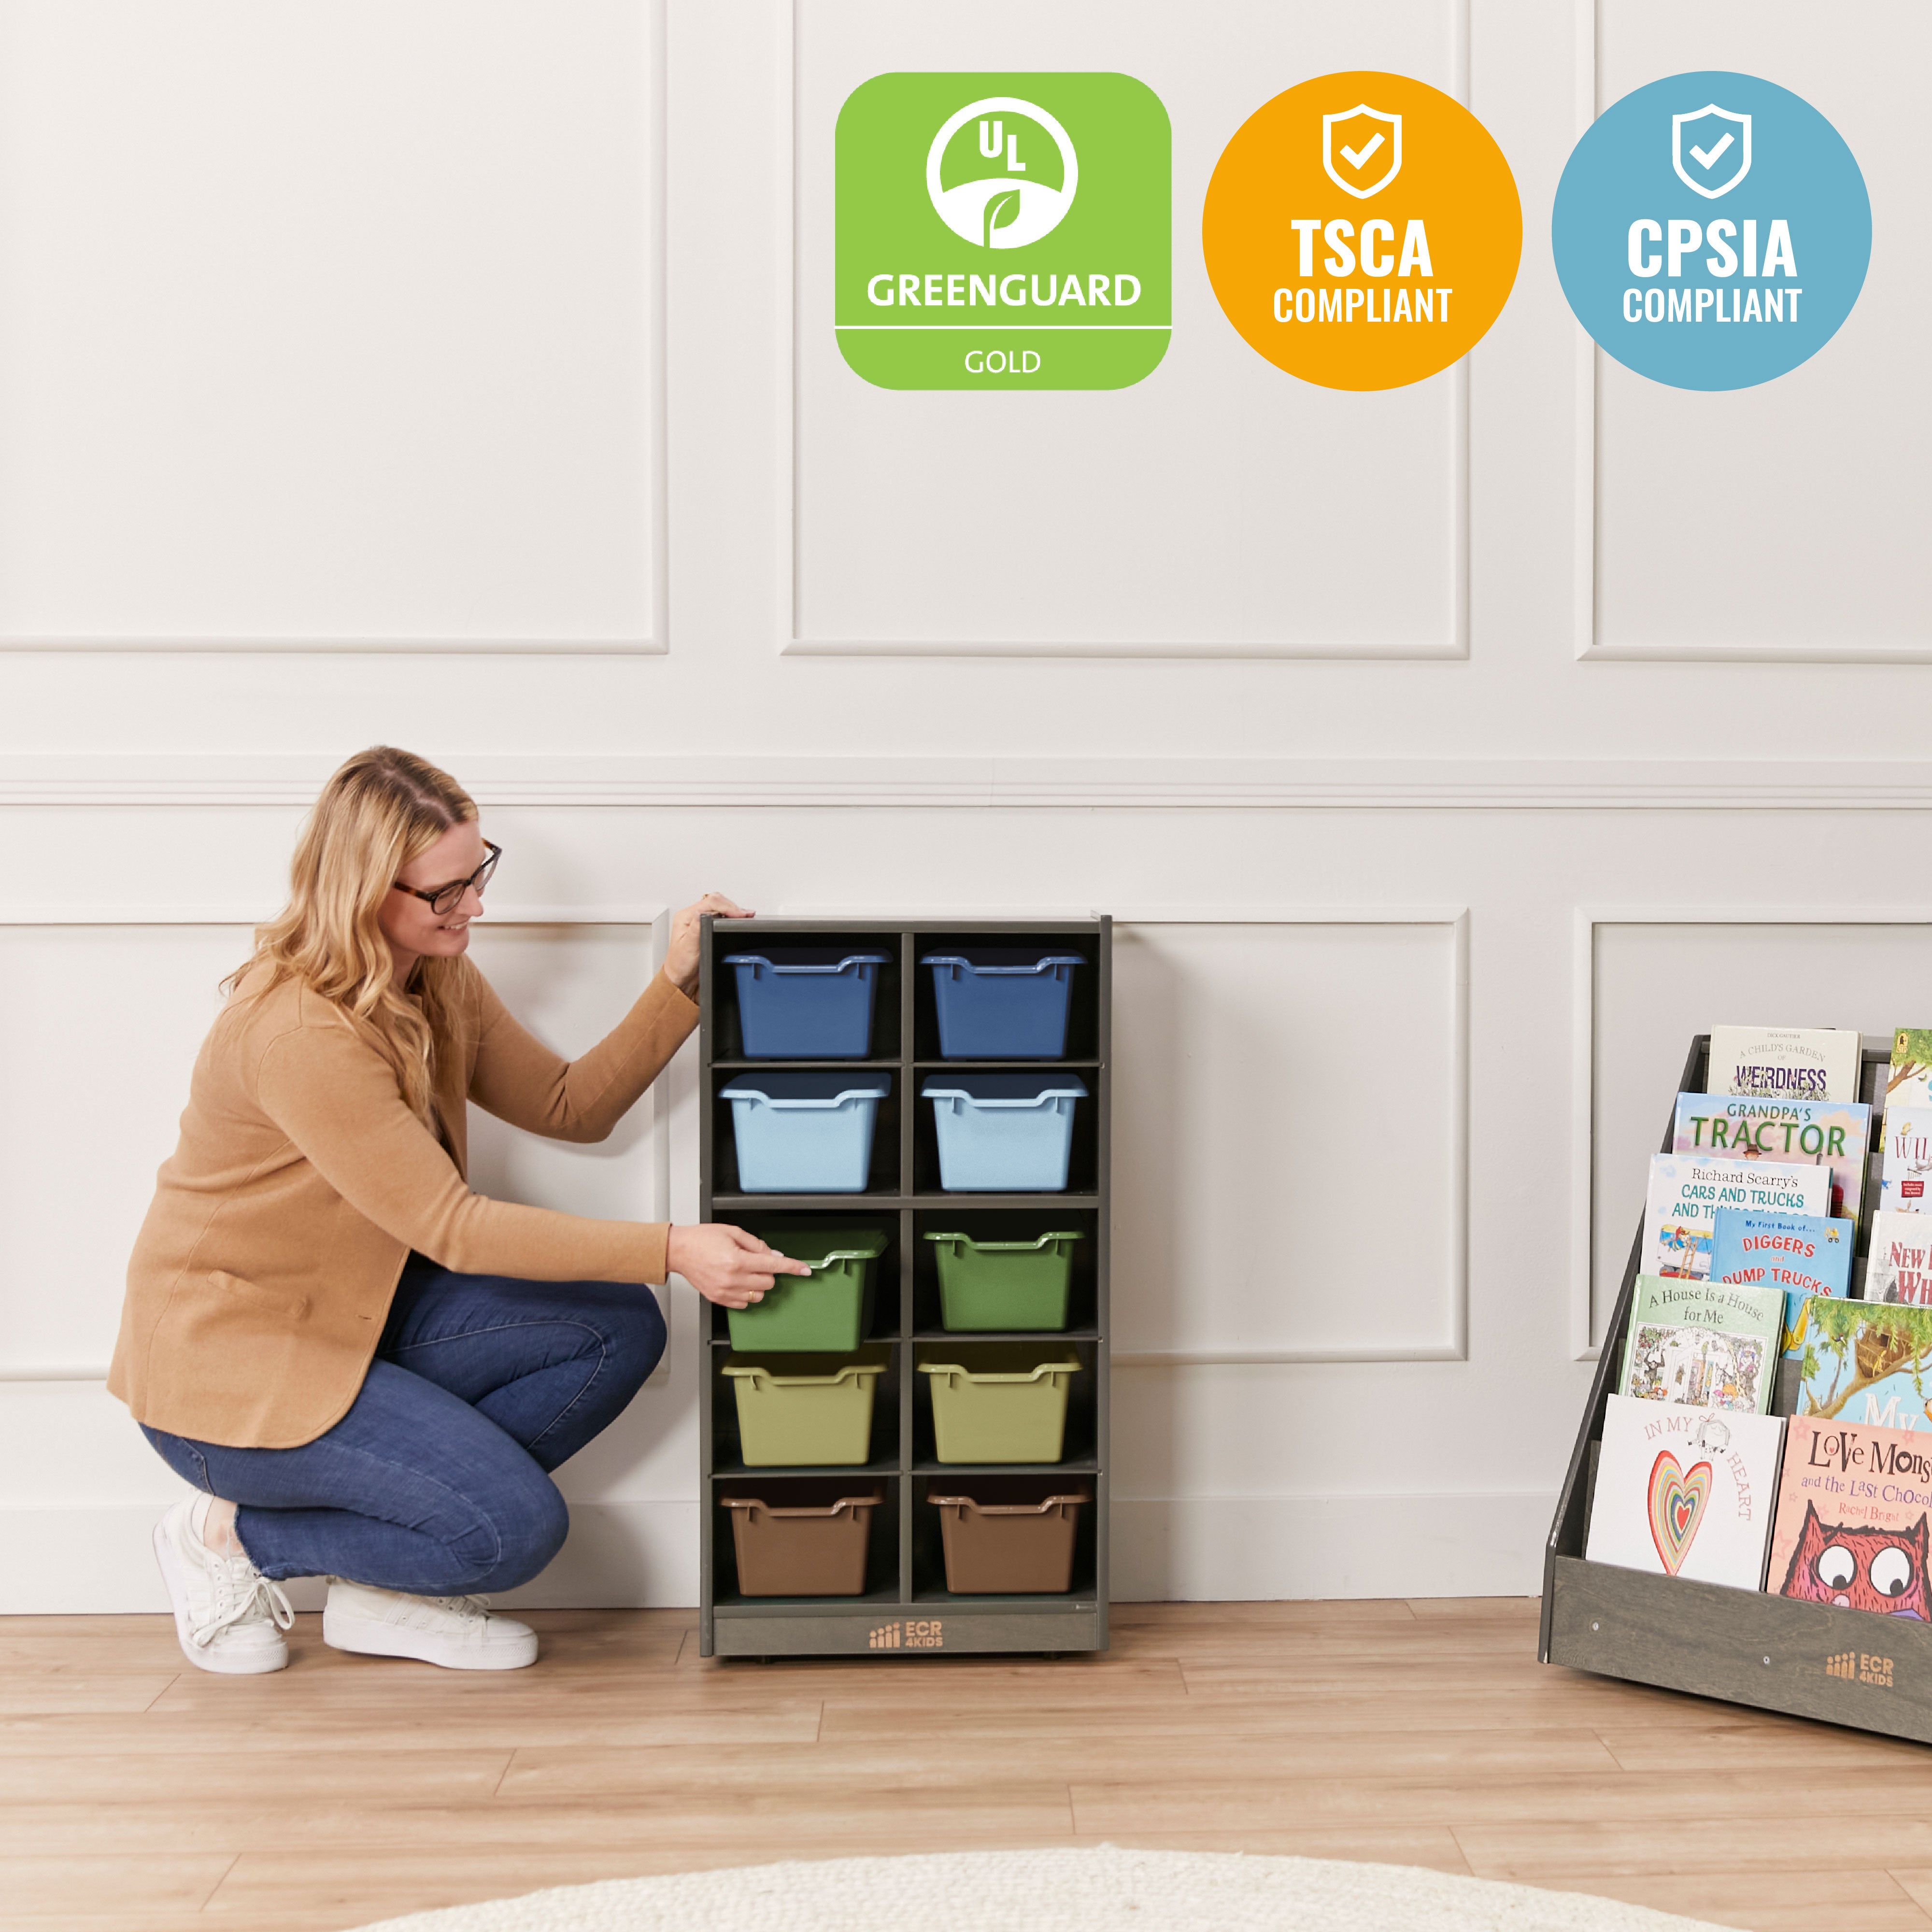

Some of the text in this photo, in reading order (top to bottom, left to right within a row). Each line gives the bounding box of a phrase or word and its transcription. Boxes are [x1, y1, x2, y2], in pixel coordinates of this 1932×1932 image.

[1740, 1043, 1826, 1062] A CHILD'S GARDEN
[1736, 1065, 1827, 1091] WEIRDNESS
[1727, 1103, 1811, 1122] GRANDPA'S
[1690, 1116, 1846, 1156] TRACTOR
[1691, 1168, 1798, 1189] Richard Scarry's
[1681, 1184, 1804, 1208] CARS AND TRUCKS
[1672, 1202, 1699, 1217] AND
[1745, 1220, 1755, 1228] My
[1742, 1235, 1816, 1257] DIGGERS
[1722, 1267, 1832, 1296] DUMP TRUCKS
[1648, 1288, 1764, 1321] A House Is a House
[1684, 1306, 1723, 1324] for Me
[1643, 1416, 1751, 1521] IN MY HEART
[1801, 1476, 1821, 1488] and
[1825, 1475, 1845, 1493] the
[1839, 1502, 1900, 1522] Rachel Bright
[906, 1620, 942, 1636] ECR
[905, 1636, 943, 1648] 4KIDS
[1860, 1653, 1894, 1675] ECR
[1859, 1671, 1894, 1687] 4KIDS
